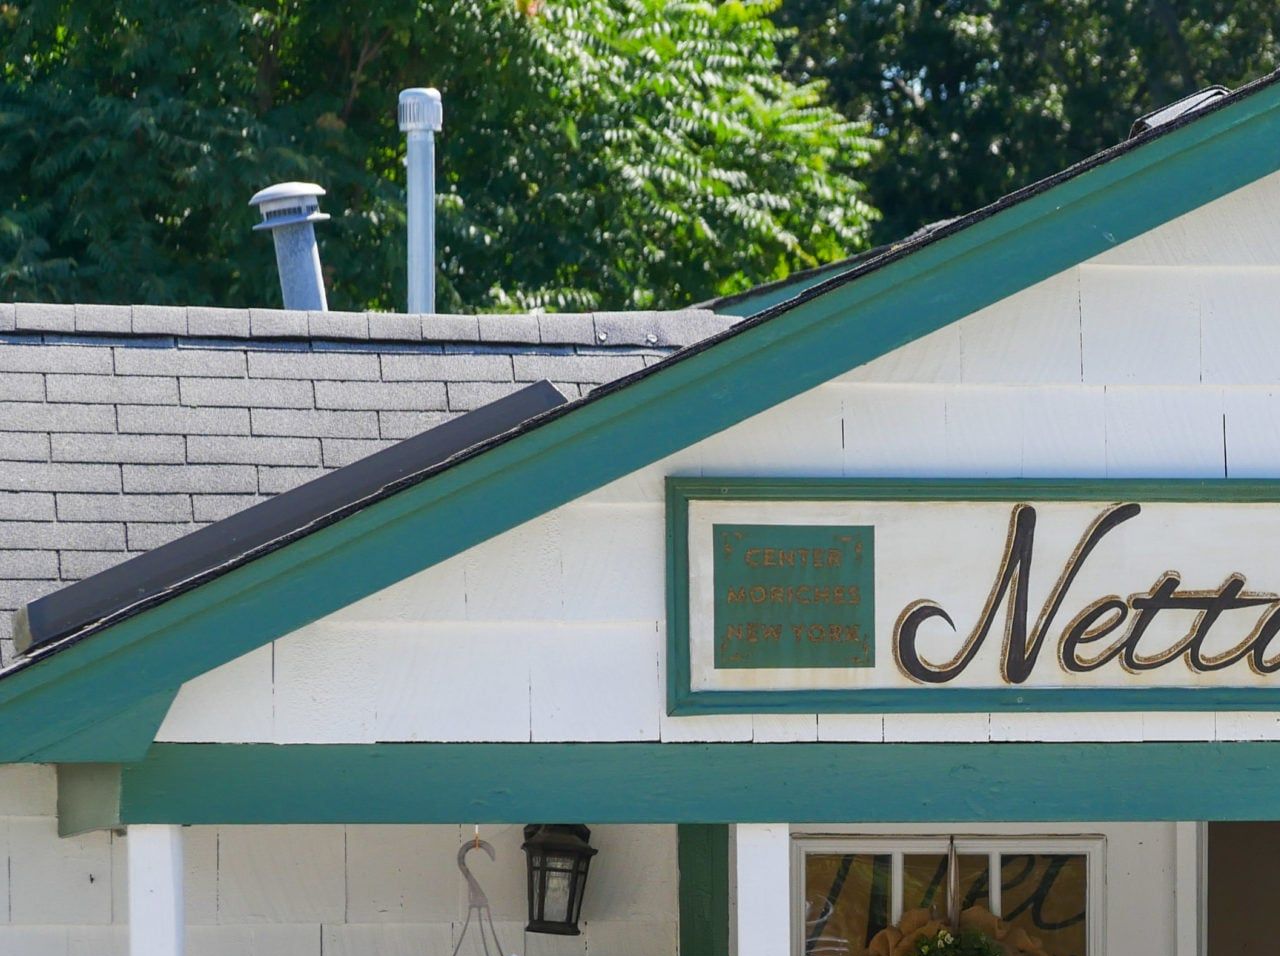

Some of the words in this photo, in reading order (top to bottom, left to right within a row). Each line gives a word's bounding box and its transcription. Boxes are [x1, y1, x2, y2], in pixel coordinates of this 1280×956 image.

[745, 548, 842, 569] CENTER
[727, 586, 861, 605] MORICHES
[727, 623, 782, 643] NEW
[792, 623, 860, 643] YORK
